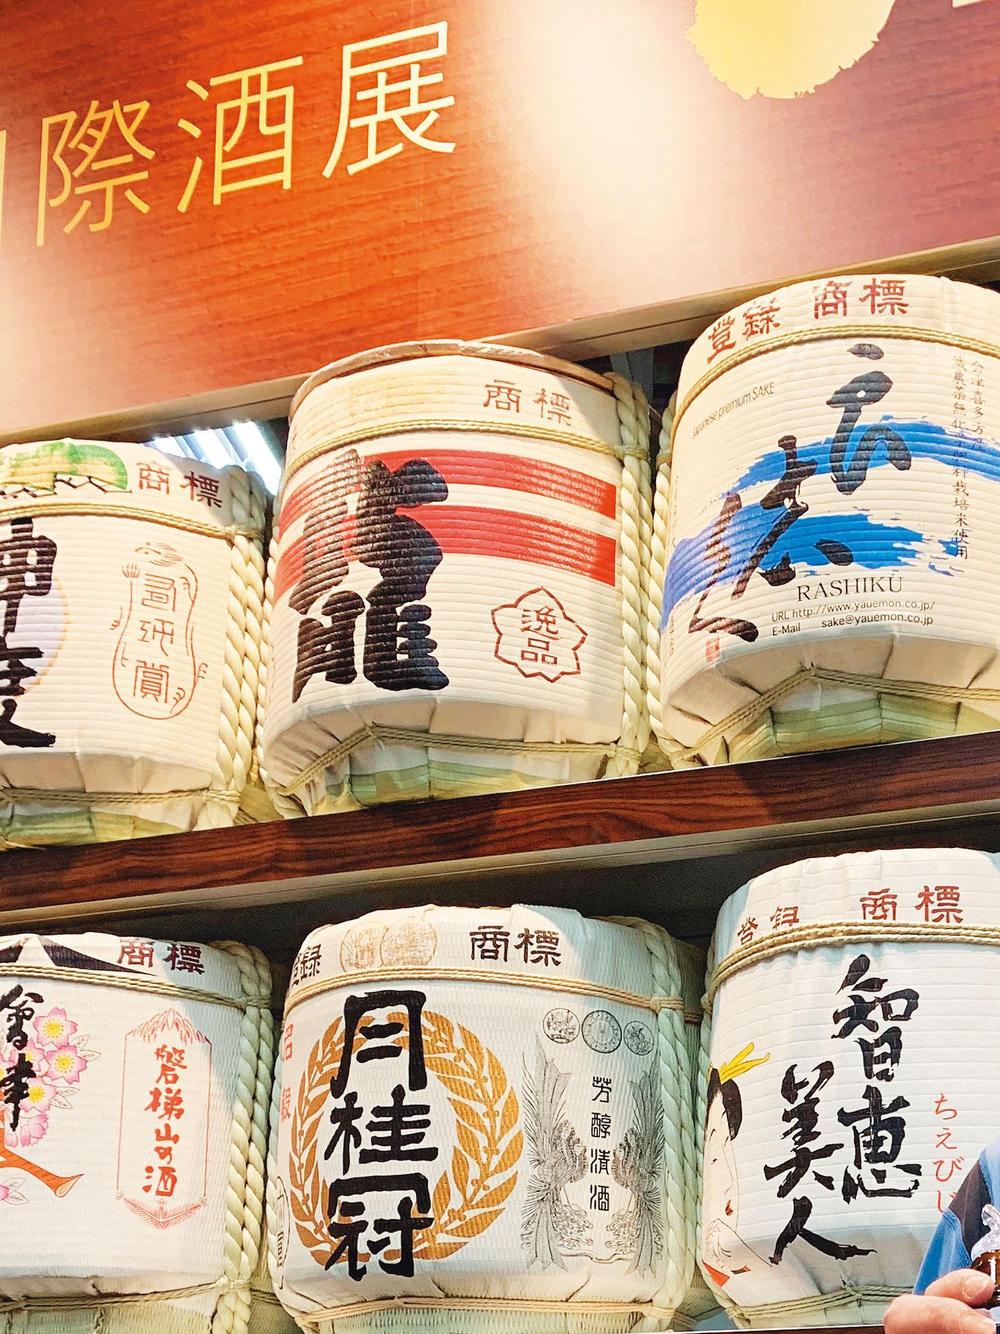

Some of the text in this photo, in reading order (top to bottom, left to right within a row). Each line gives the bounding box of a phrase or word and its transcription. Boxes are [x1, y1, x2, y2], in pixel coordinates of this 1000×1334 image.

[0, 20, 456, 247] 際酒展
[707, 277, 910, 364] 登録 商標
[482, 380, 573, 426] 商標
[718, 393, 752, 424] premium
[752, 381, 776, 402] SAKE
[136, 460, 223, 508] 商標
[797, 575, 904, 601] RASHIKU
[772, 610, 790, 623] URL
[772, 613, 934, 636] E-Mail sake@yauemon.co.jp
[117, 937, 206, 974] 商標
[469, 925, 562, 967] 商標
[324, 989, 439, 1282] 月桂冠
[589, 1075, 613, 1213] 芳醇清酒
